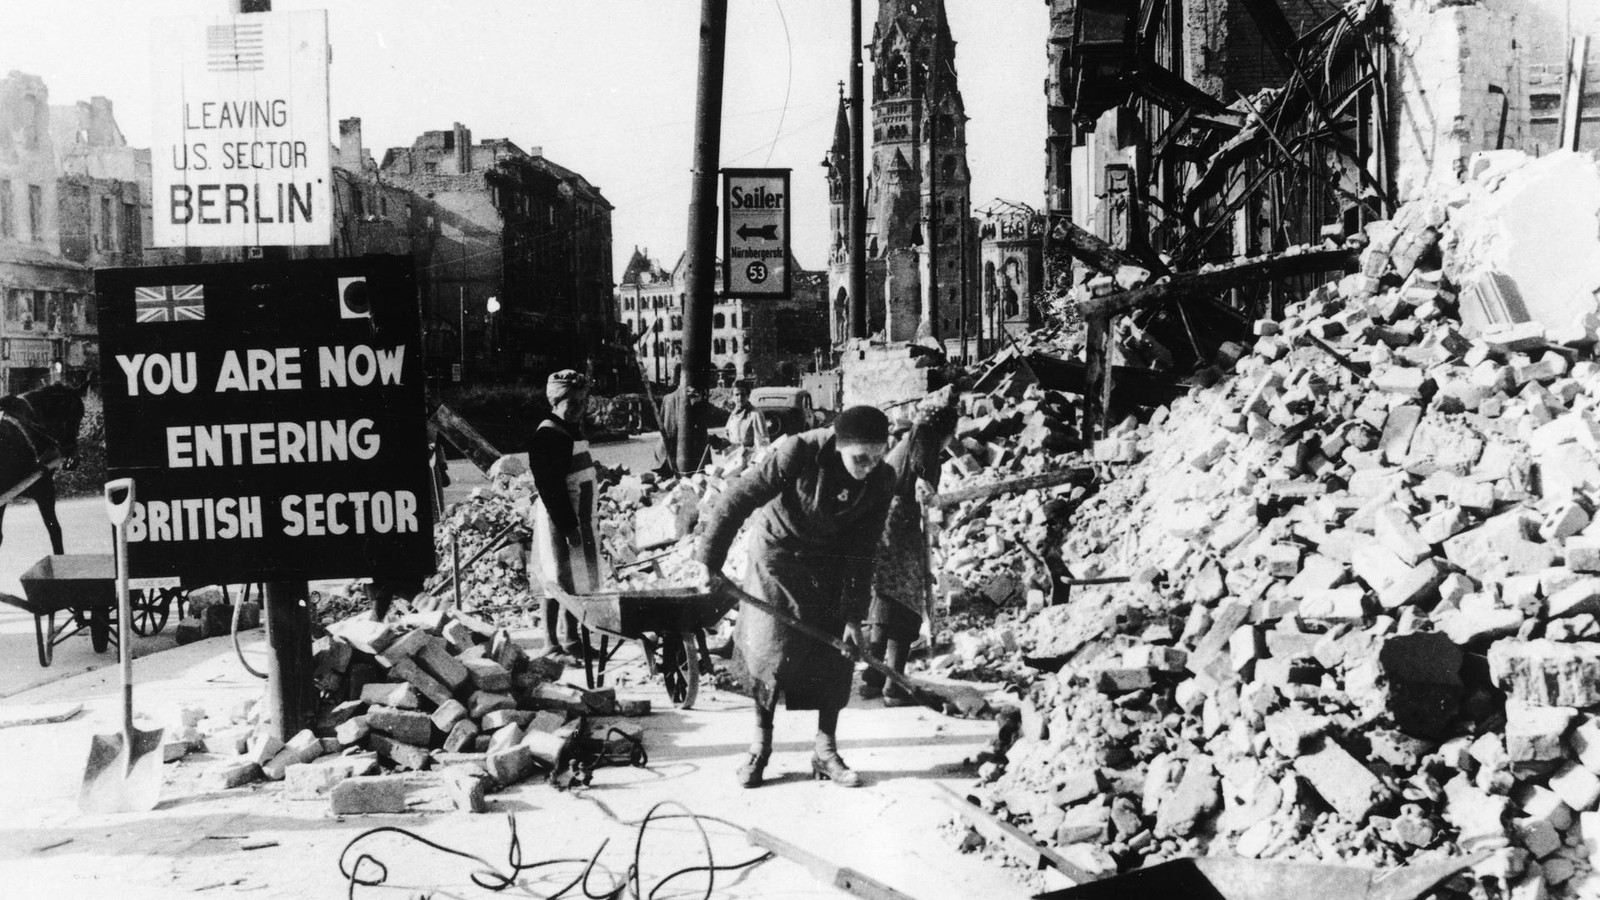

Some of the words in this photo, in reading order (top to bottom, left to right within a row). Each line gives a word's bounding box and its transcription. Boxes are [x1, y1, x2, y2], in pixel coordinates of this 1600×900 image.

[186, 99, 287, 129] LEAVING
[172, 144, 212, 170] U.S.
[223, 141, 307, 170] SECTOR
[170, 183, 313, 225] BERLIN
[731, 185, 783, 209] Sailer
[750, 266, 765, 280] 53
[115, 352, 198, 396] YOU
[215, 347, 302, 393] ARE
[318, 344, 405, 389] NOW
[166, 418, 381, 469] ENTERING
[127, 496, 263, 543] BRITISH
[281, 490, 418, 537] SECTOR
